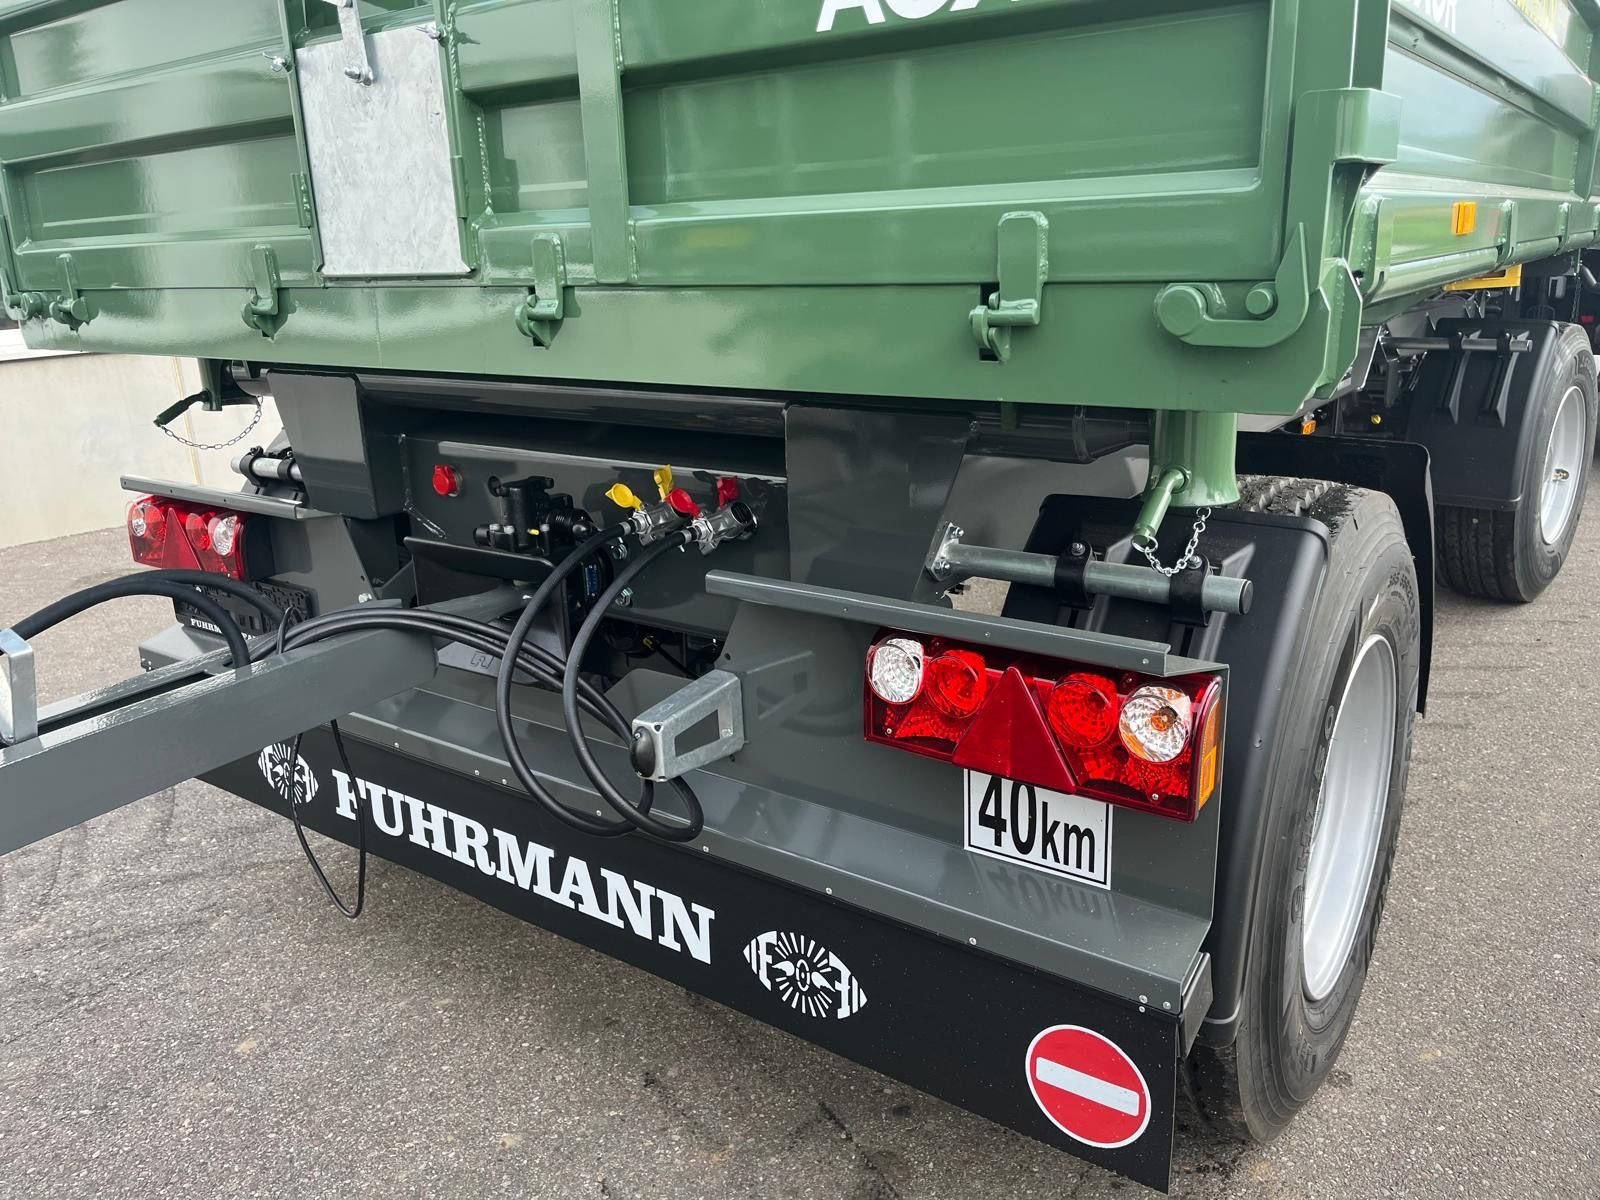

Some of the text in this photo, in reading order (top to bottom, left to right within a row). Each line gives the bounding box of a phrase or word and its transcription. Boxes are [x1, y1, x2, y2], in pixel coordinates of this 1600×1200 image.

[190, 617, 223, 634] FUHRM
[331, 768, 715, 965] FUHRMANN
[978, 775, 1095, 873] 40km
